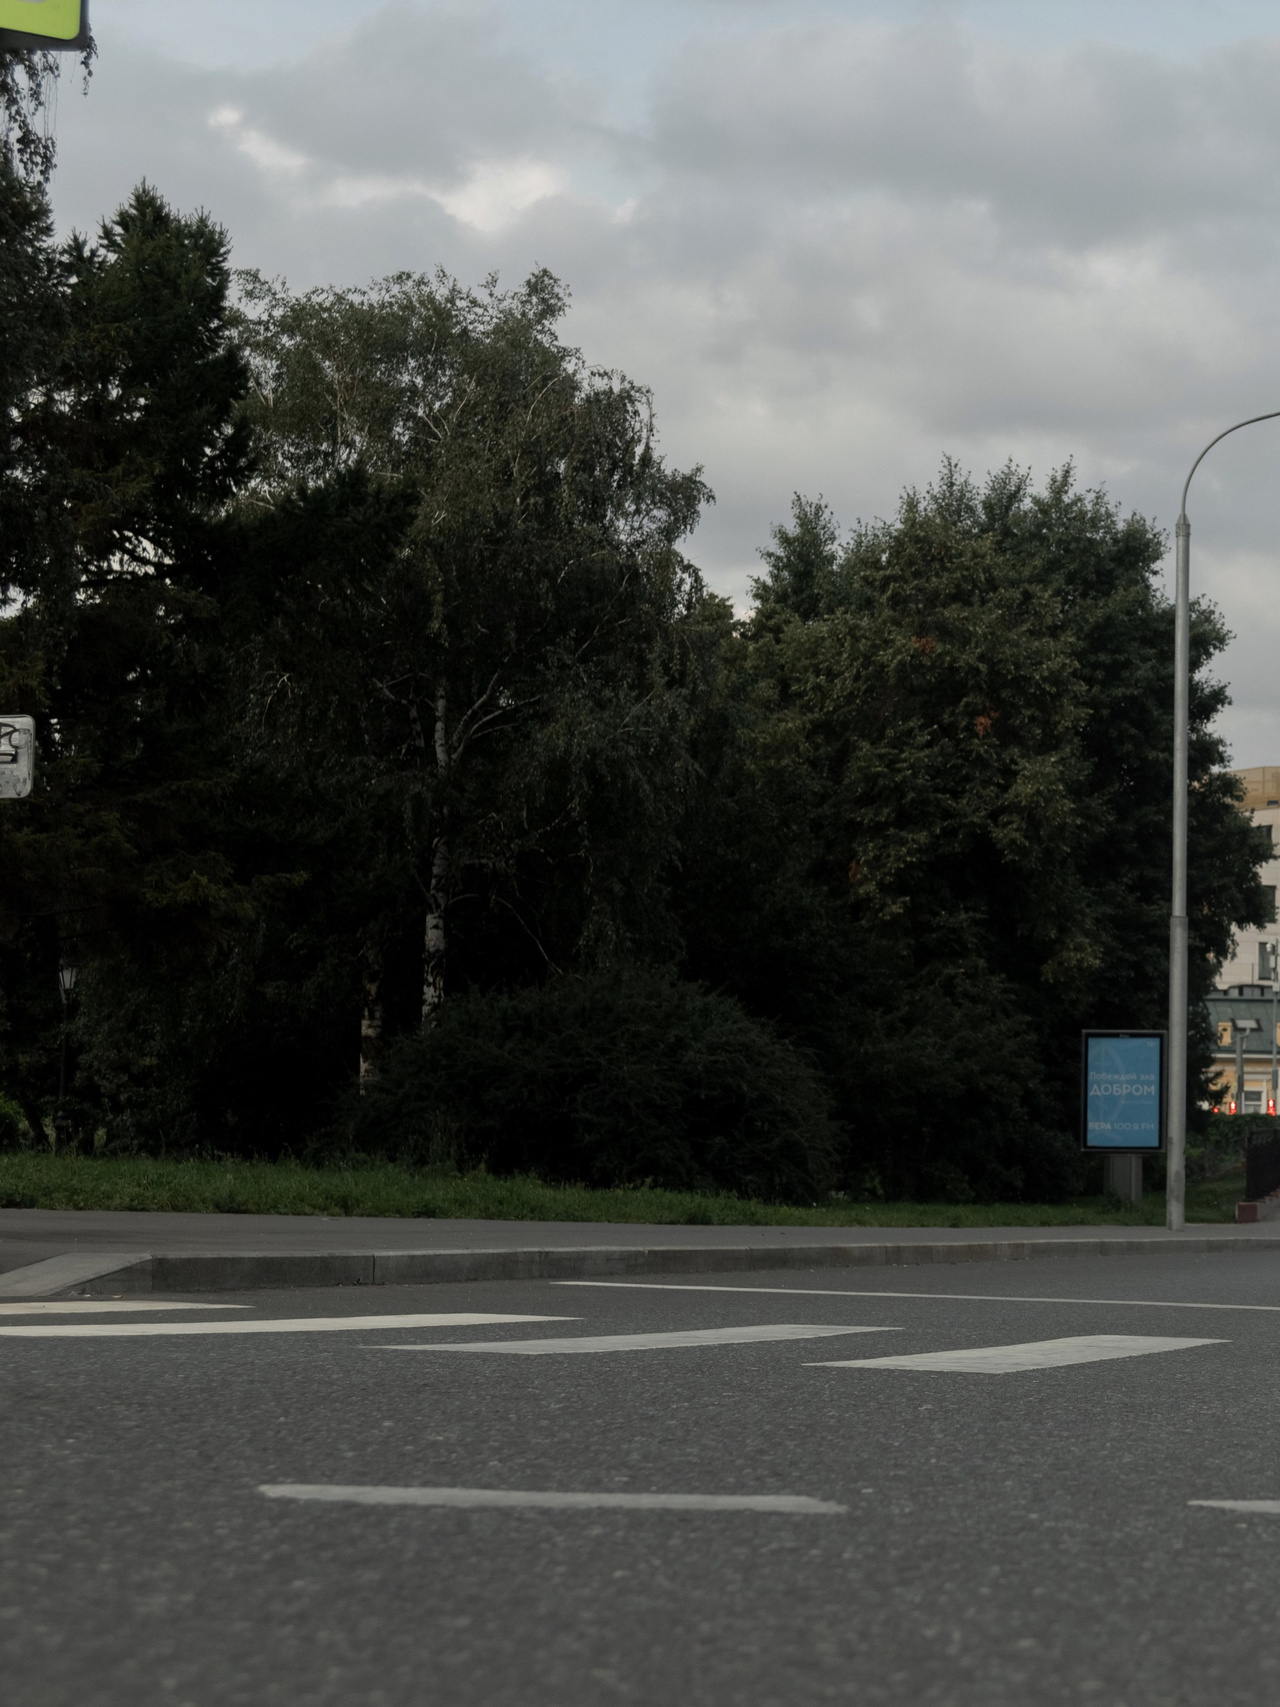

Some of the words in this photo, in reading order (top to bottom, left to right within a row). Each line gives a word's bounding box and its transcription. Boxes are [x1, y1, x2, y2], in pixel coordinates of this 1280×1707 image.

[1090, 1083, 1155, 1096] ДОБРОМ
[1088, 1122, 1112, 1130] ВЕРА
[1113, 1122, 1138, 1130] 100.9
[1141, 1122, 1155, 1130] FM
